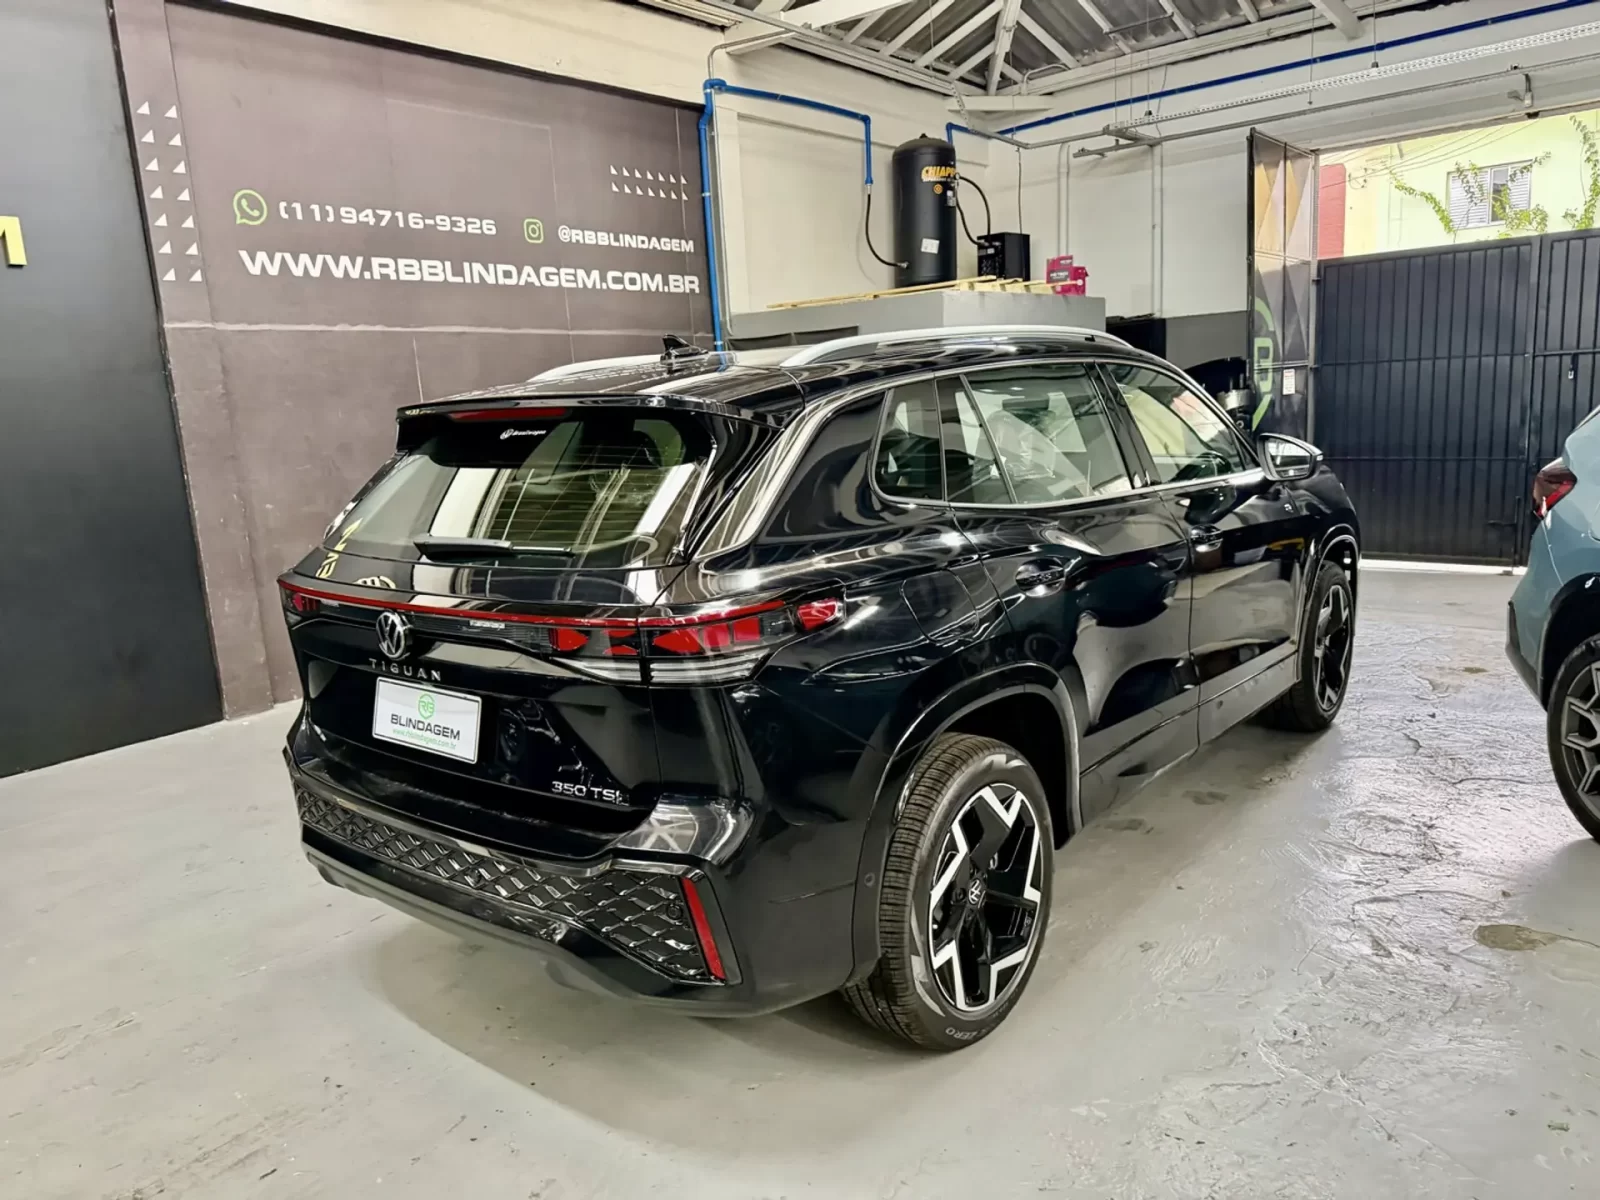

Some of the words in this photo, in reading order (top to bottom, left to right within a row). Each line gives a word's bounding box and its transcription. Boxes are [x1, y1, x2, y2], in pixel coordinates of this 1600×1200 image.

[558, 224, 694, 252] @RBBLINDAGEM
[238, 249, 700, 294] WWW.RBBLINDAGEM.COM.BR
[368, 657, 442, 682] TIGUAN
[390, 713, 461, 741] BLINDAGEM
[551, 781, 587, 797] 350
[945, 1026, 978, 1040] ZERO
